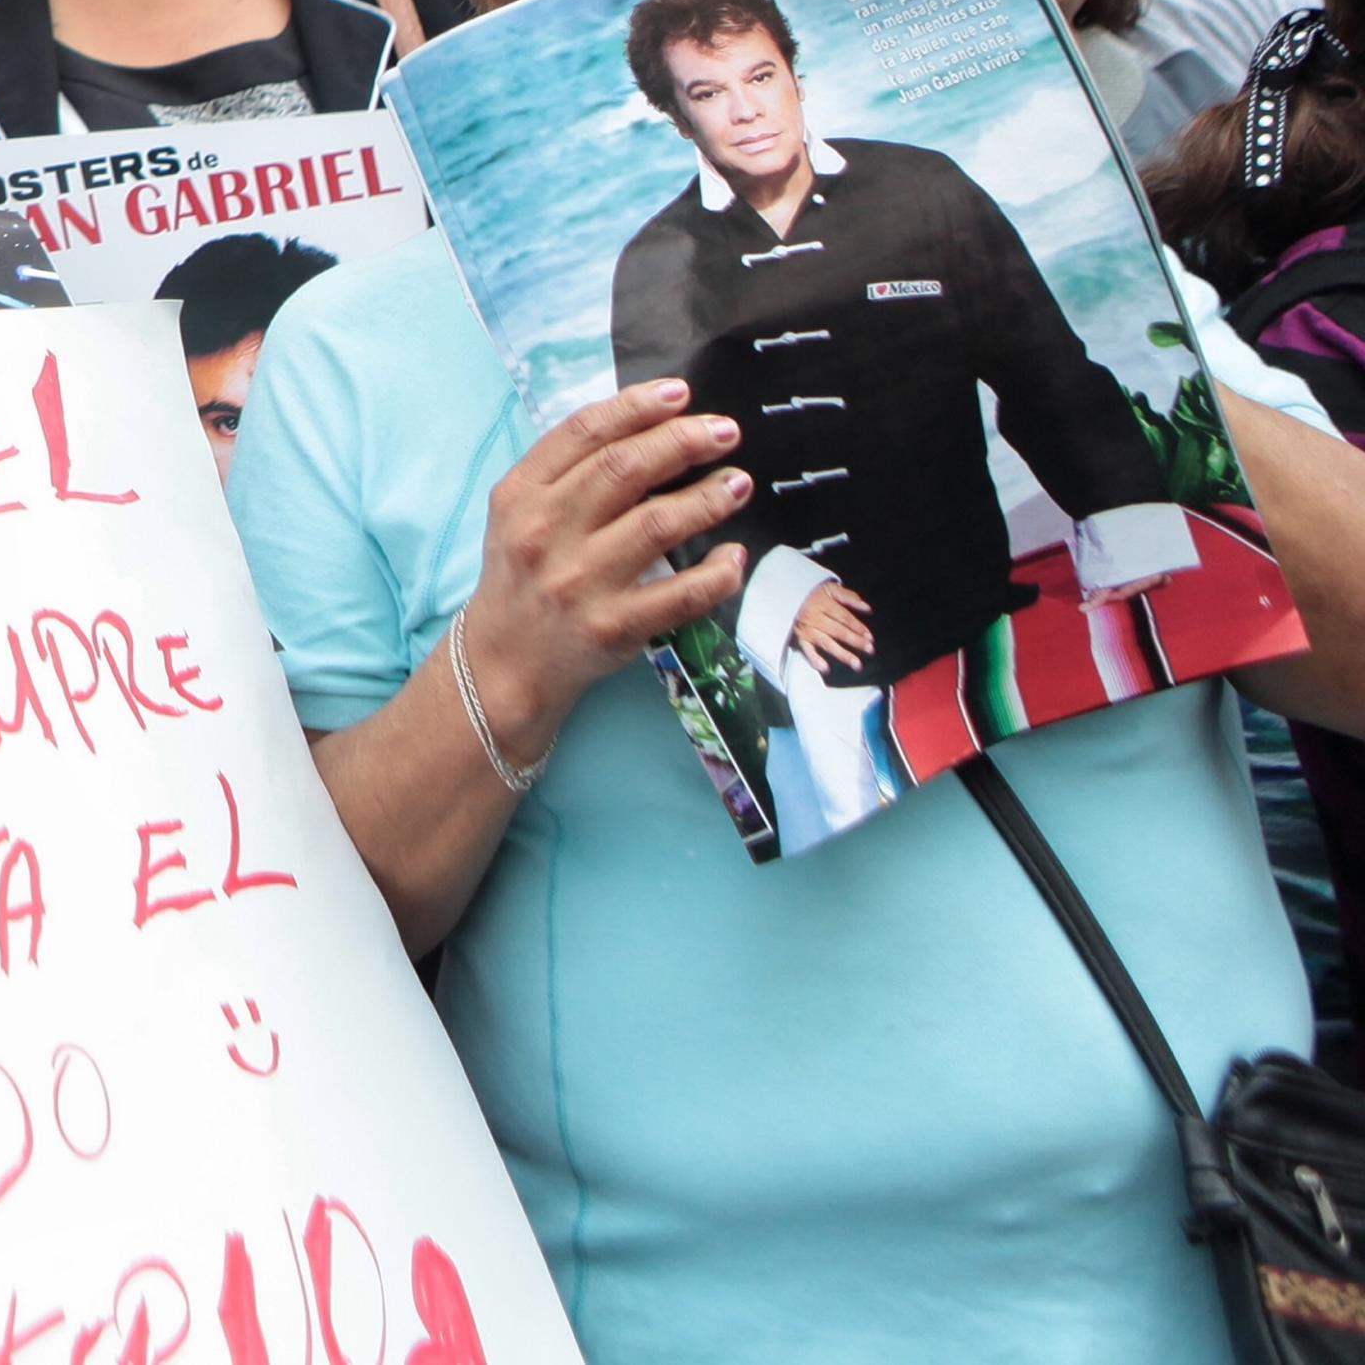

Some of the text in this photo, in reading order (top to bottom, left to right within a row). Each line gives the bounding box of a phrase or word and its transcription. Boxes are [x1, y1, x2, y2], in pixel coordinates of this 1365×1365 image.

[862, 21, 882, 36] un
[871, 34, 901, 53] dos:
[879, 56, 897, 70] ta
[899, 36, 949, 63] alguien
[952, 25, 977, 44] que
[888, 73, 906, 87] te
[910, 60, 936, 79] mis
[899, 83, 933, 104] Juan
[932, 62, 982, 91] Gabriel
[187, 150, 220, 172] de
[25, 145, 404, 253] AN GABRIEL
[888, 281, 940, 295] México
[132, 772, 299, 930] EL
